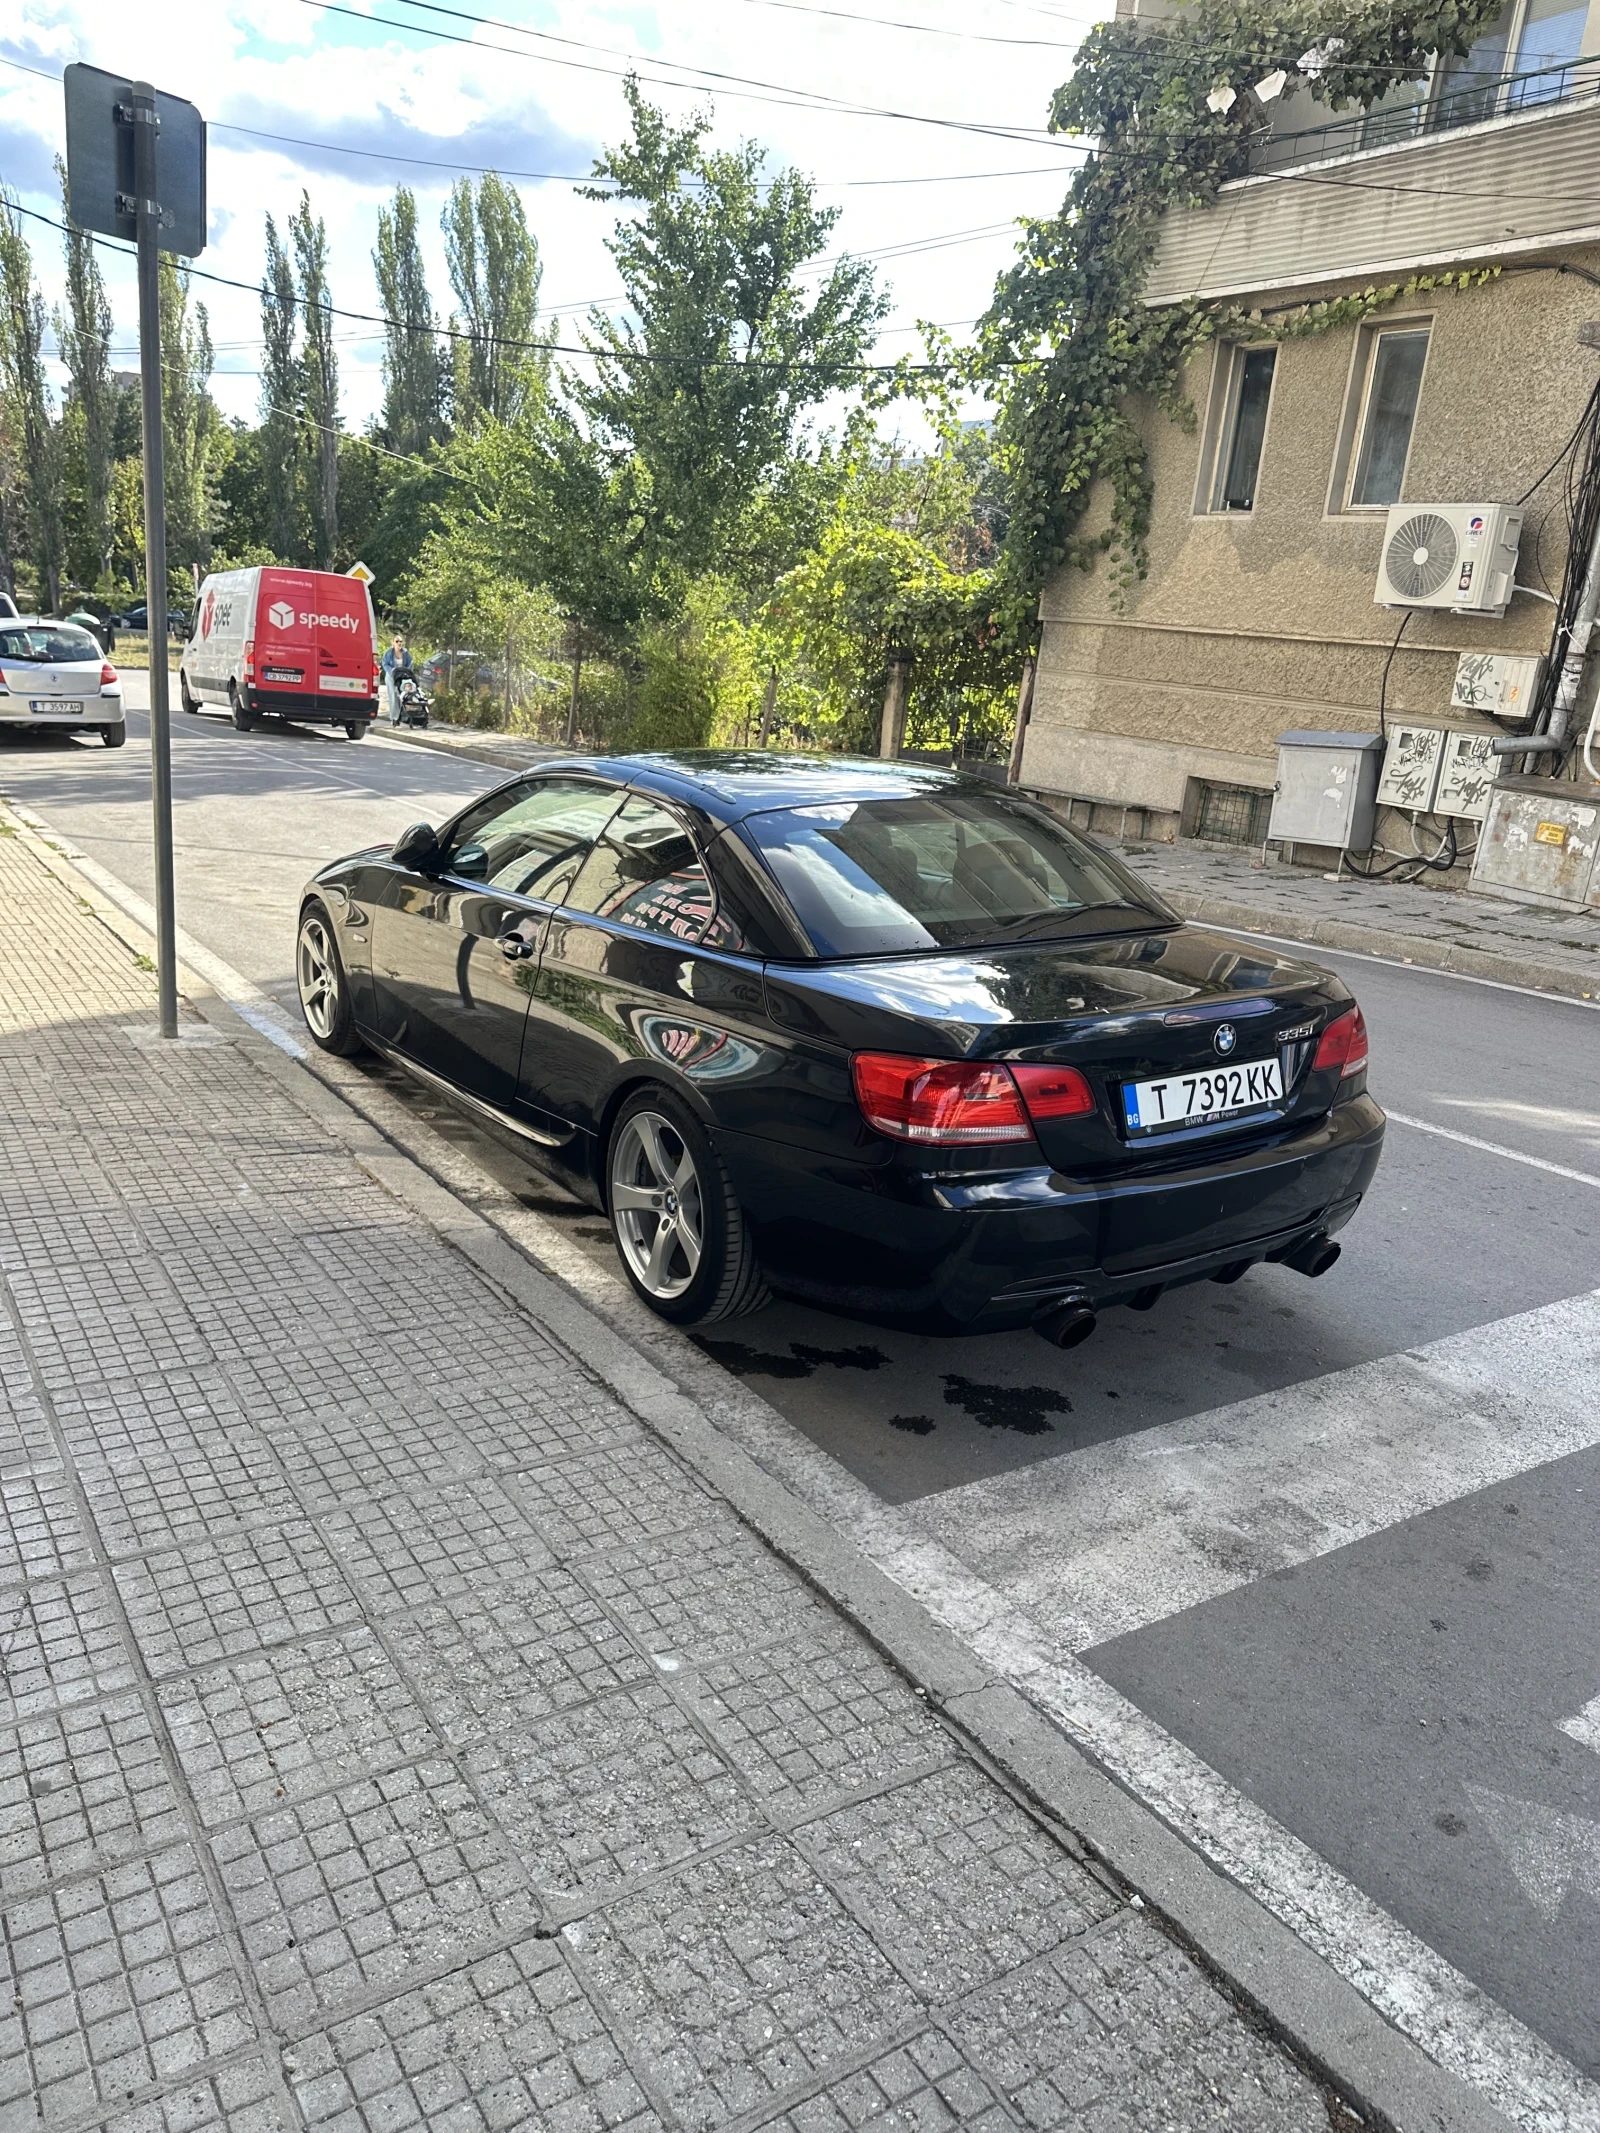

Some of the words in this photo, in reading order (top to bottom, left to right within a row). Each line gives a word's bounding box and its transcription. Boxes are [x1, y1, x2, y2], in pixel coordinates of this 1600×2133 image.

[299, 612, 360, 634] speedy
[1151, 1084, 1167, 1120] T
[1127, 1113, 1139, 1126] BG
[1184, 1115, 1204, 1126] BMW
[1221, 1110, 1239, 1119] Power
